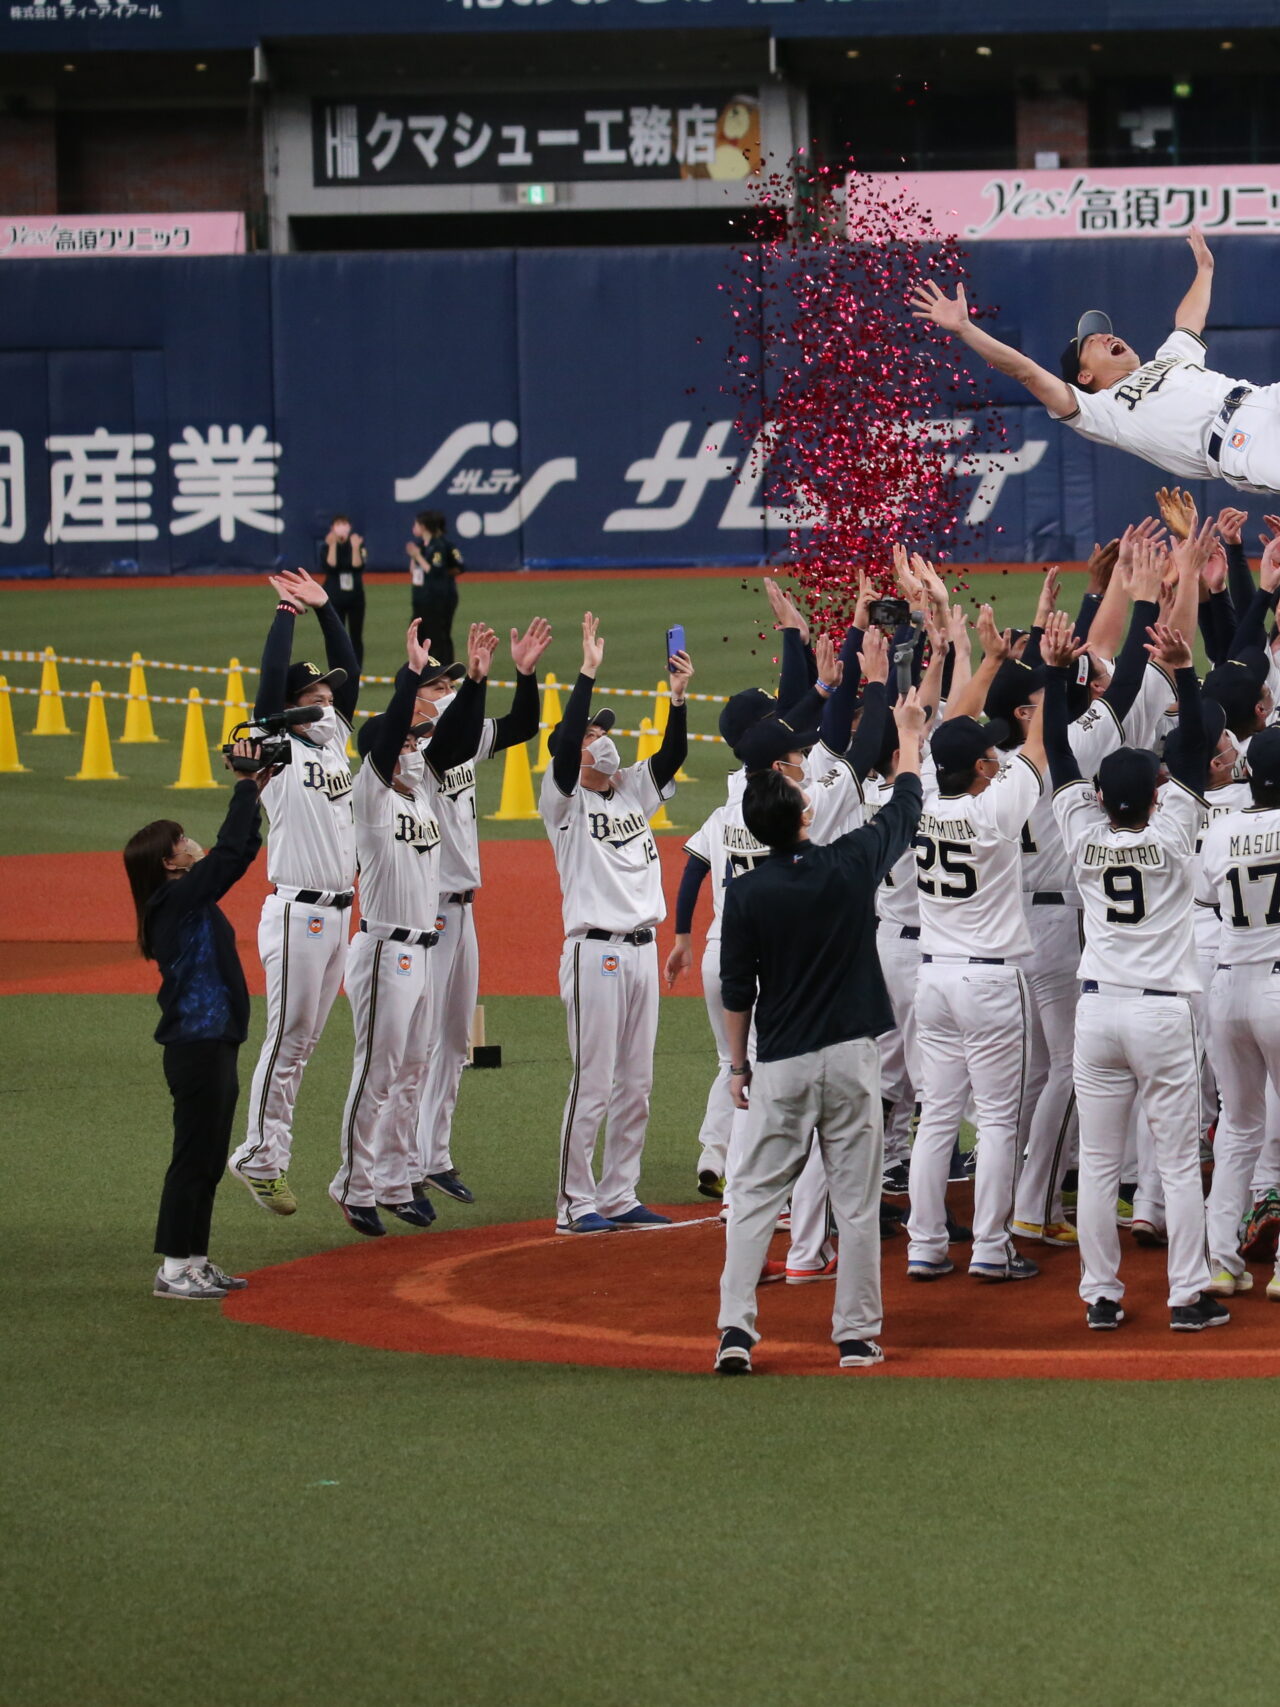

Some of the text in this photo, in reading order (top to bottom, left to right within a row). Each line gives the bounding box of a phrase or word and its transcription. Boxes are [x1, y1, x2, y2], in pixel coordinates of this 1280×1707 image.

[366, 105, 717, 171] クマシュー工務店
[0, 424, 285, 544] 産業
[643, 838, 657, 864] 12
[910, 835, 979, 899] 25
[1102, 865, 1147, 925] 9
